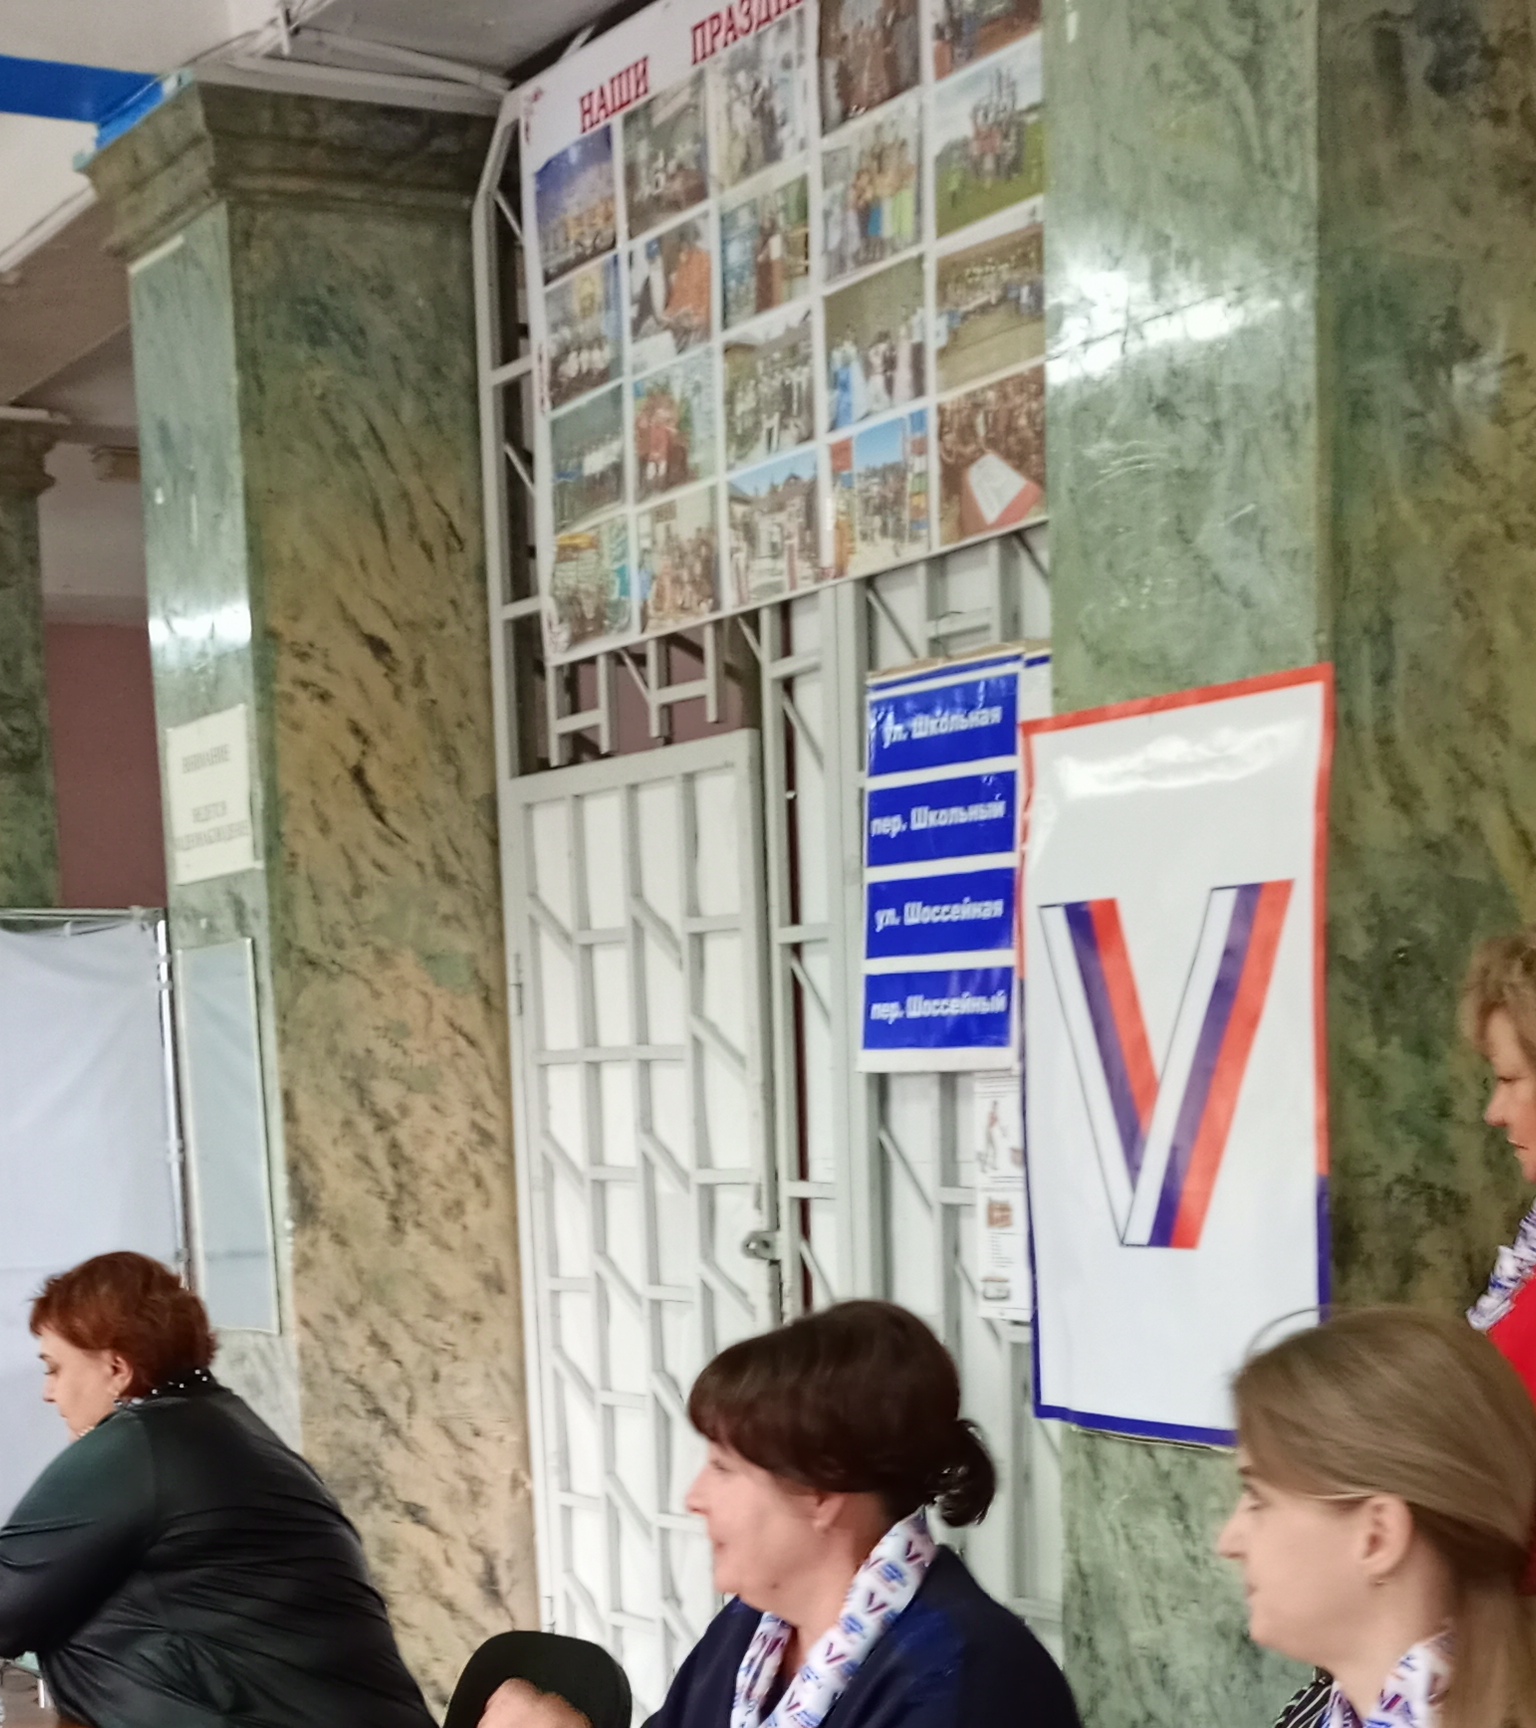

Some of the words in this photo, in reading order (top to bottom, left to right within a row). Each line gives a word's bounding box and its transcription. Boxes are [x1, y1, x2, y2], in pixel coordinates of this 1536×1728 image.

[579, 55, 650, 133] НАШИ
[691, 0, 804, 65] ПРАЗД
[882, 722, 909, 749] ул.
[911, 706, 1003, 739] Школьная
[870, 813, 908, 838] пер.
[910, 799, 1007, 831] Школьный
[874, 908, 901, 933] ул.
[904, 896, 1005, 926] Шоссейная
[870, 1002, 905, 1025] пер.
[905, 989, 1008, 1019] Шоссейный
